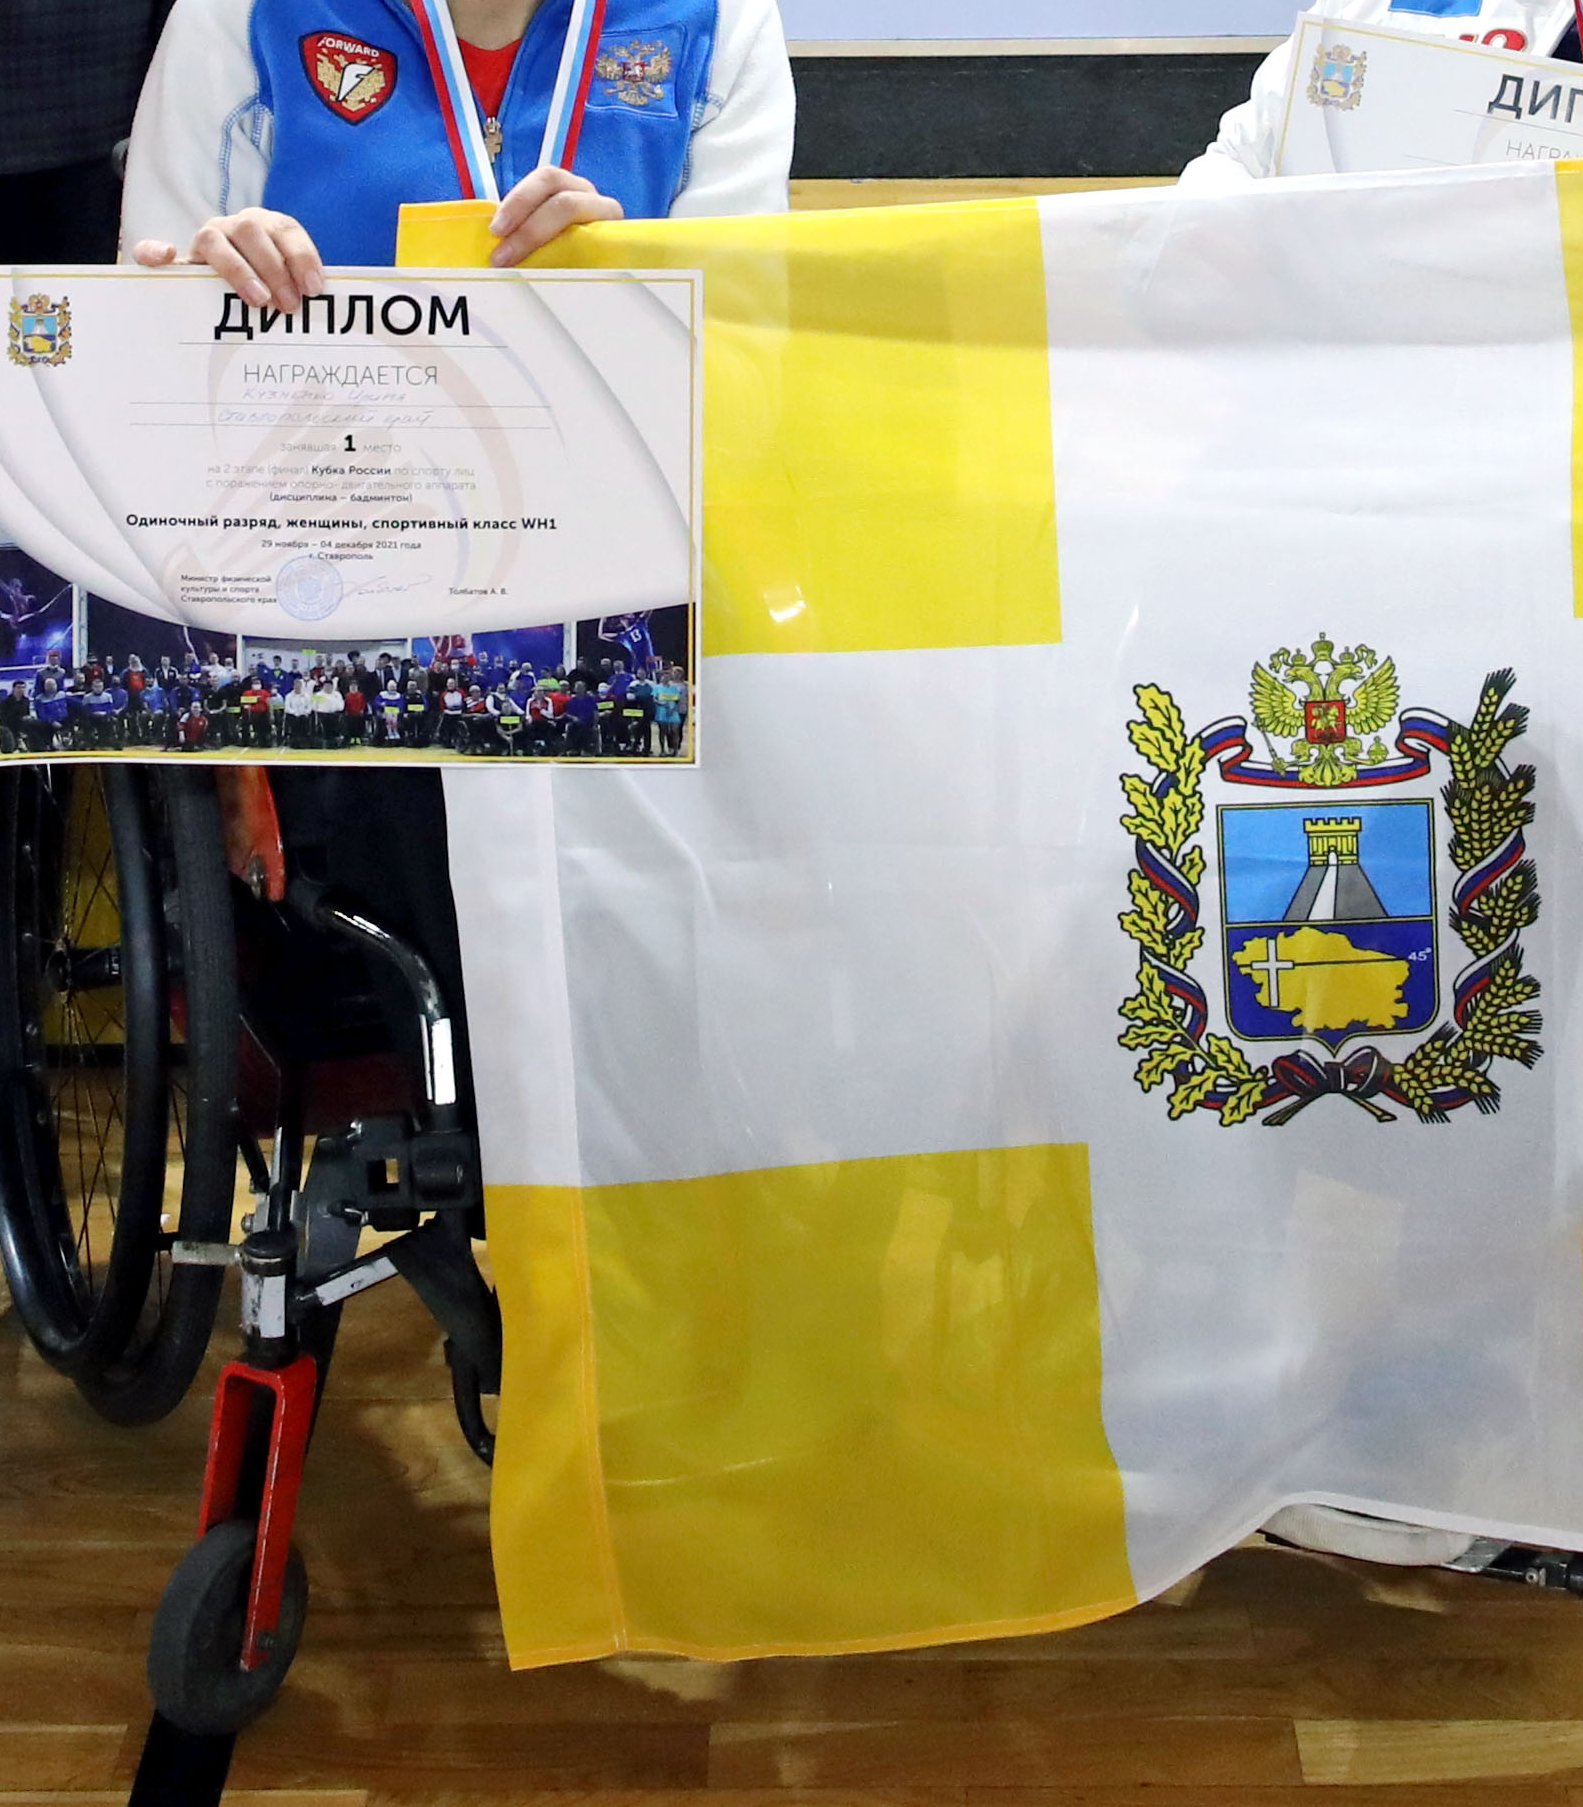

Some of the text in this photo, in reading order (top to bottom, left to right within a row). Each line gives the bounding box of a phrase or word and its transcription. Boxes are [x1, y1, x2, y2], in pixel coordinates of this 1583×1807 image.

[318, 36, 380, 58] FORWARD
[214, 293, 470, 340] ДИПЛОМ
[244, 363, 438, 387] НАГРАЖДАЕТСЯ
[344, 434, 356, 452] 1
[363, 444, 402, 452] место
[311, 465, 345, 476] Кубка
[348, 465, 392, 476] России
[269, 492, 338, 503] (дисциплина
[350, 492, 413, 503] бадминтон)
[126, 513, 557, 532] Одиночный разряд, женщины, спортивный класс WH1
[261, 540, 273, 548] 29
[320, 540, 333, 549] 04
[334, 541, 374, 551] декабря
[376, 540, 398, 549] 2021
[400, 542, 422, 551] года
[317, 551, 374, 562] Ставрополь
